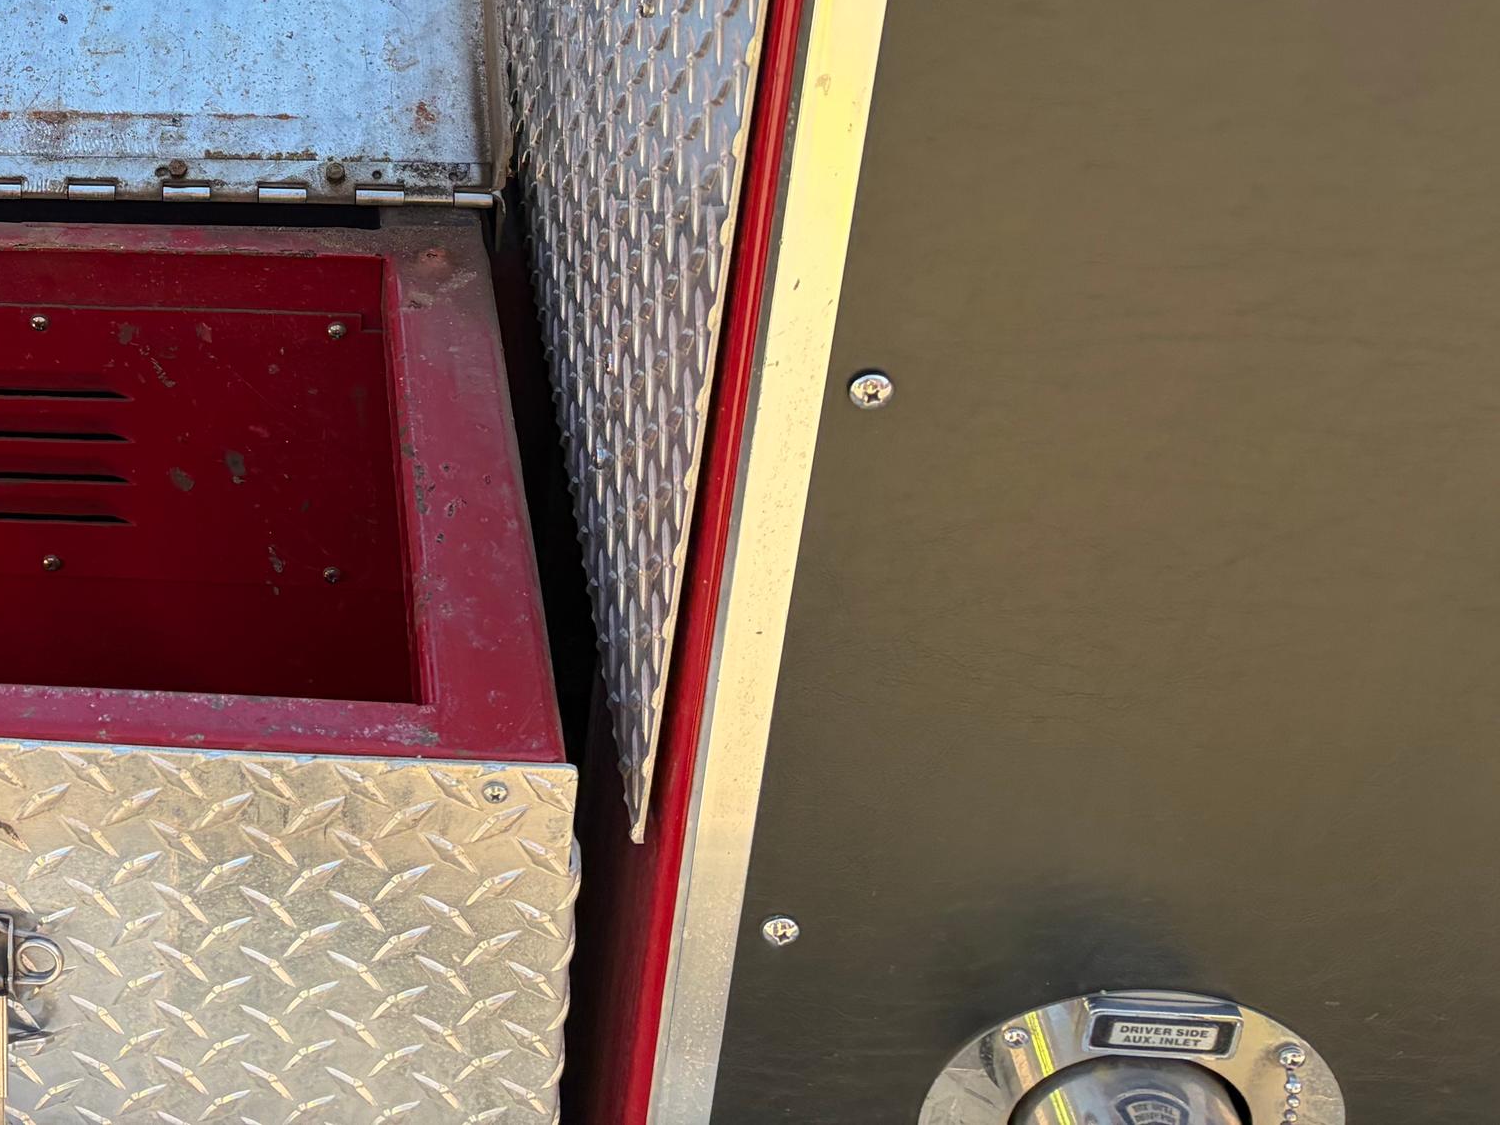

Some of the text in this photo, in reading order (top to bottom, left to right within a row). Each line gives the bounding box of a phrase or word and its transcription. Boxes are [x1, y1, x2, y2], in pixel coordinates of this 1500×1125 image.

[1119, 1025, 1209, 1038] DRIVER SIDE
[1123, 1035, 1202, 1047] AUX. INLET
